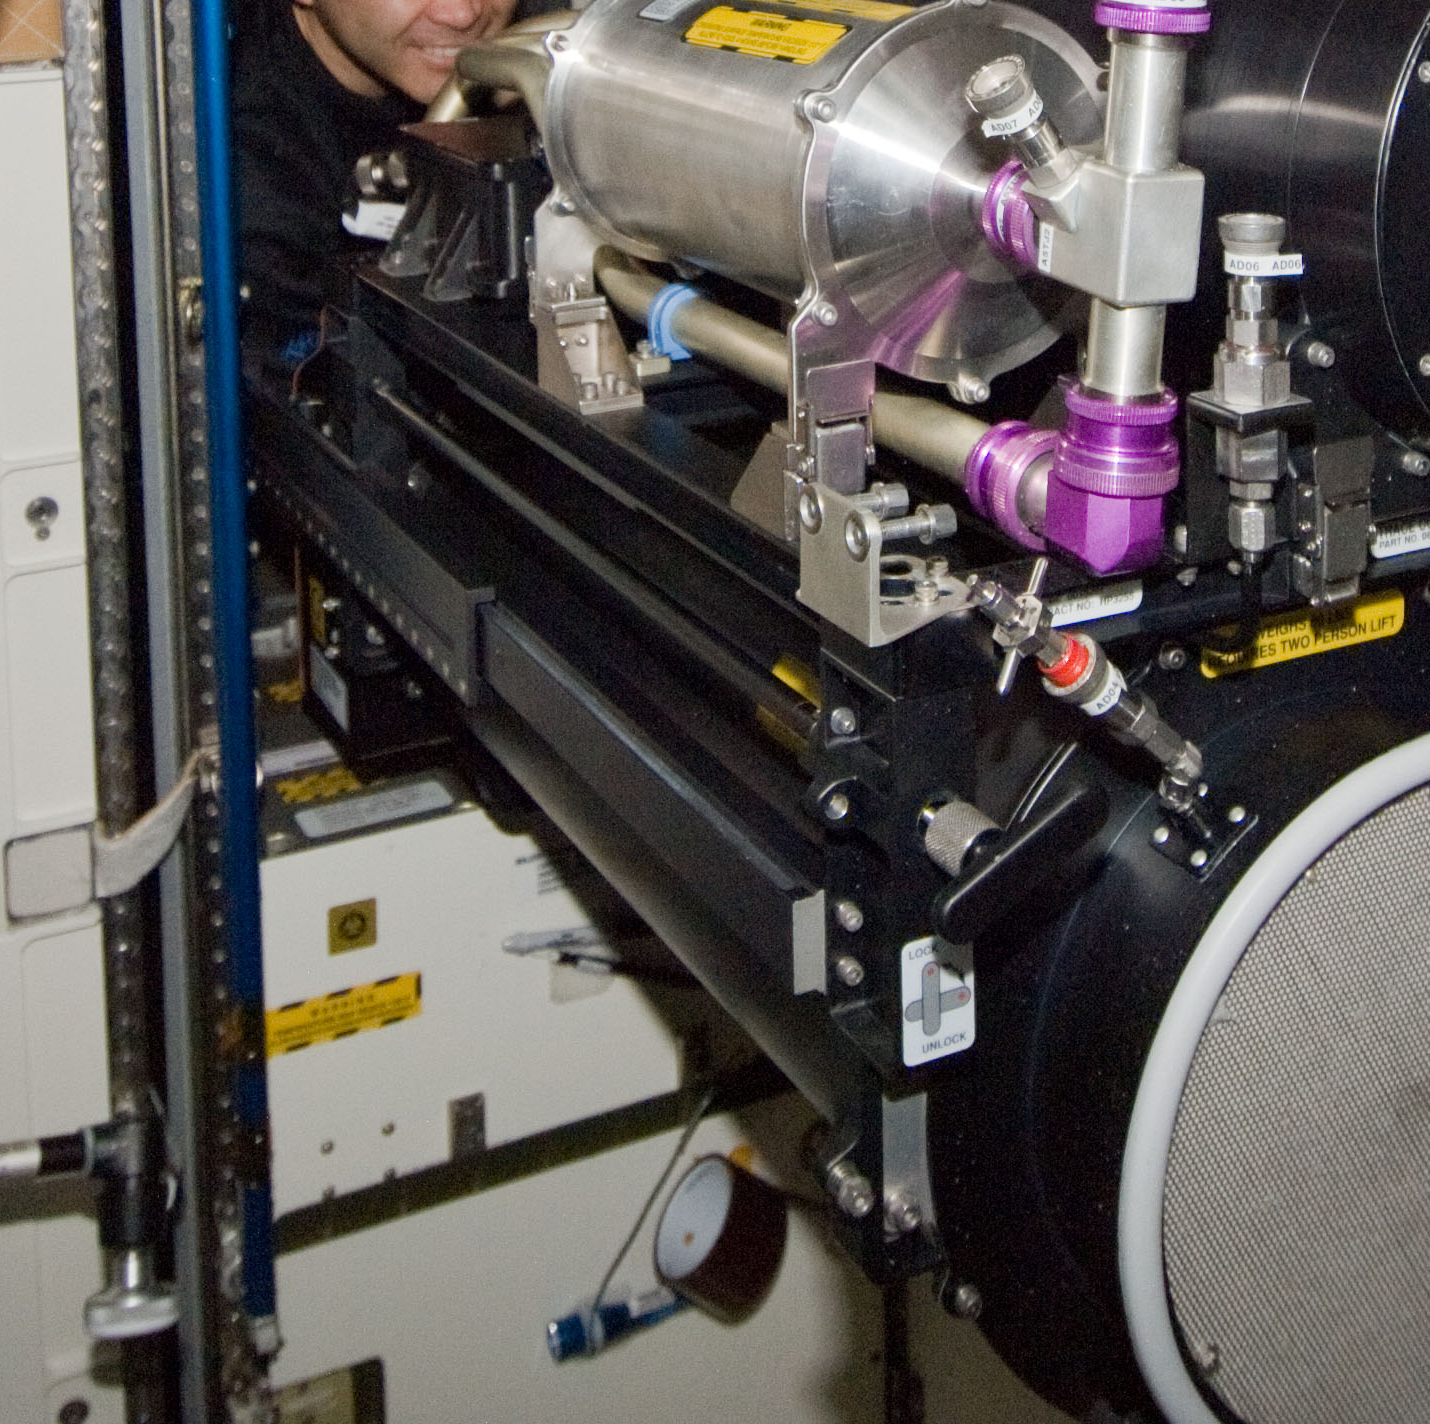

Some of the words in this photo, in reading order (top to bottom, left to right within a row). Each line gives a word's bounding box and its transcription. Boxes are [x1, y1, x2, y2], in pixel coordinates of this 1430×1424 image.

[1379, 539, 1401, 549] PART
[1281, 635, 1311, 653] TWO
[1314, 622, 1368, 646] PERSON
[1370, 614, 1397, 632] LIFT
[922, 1032, 967, 1054] UNLOCK
